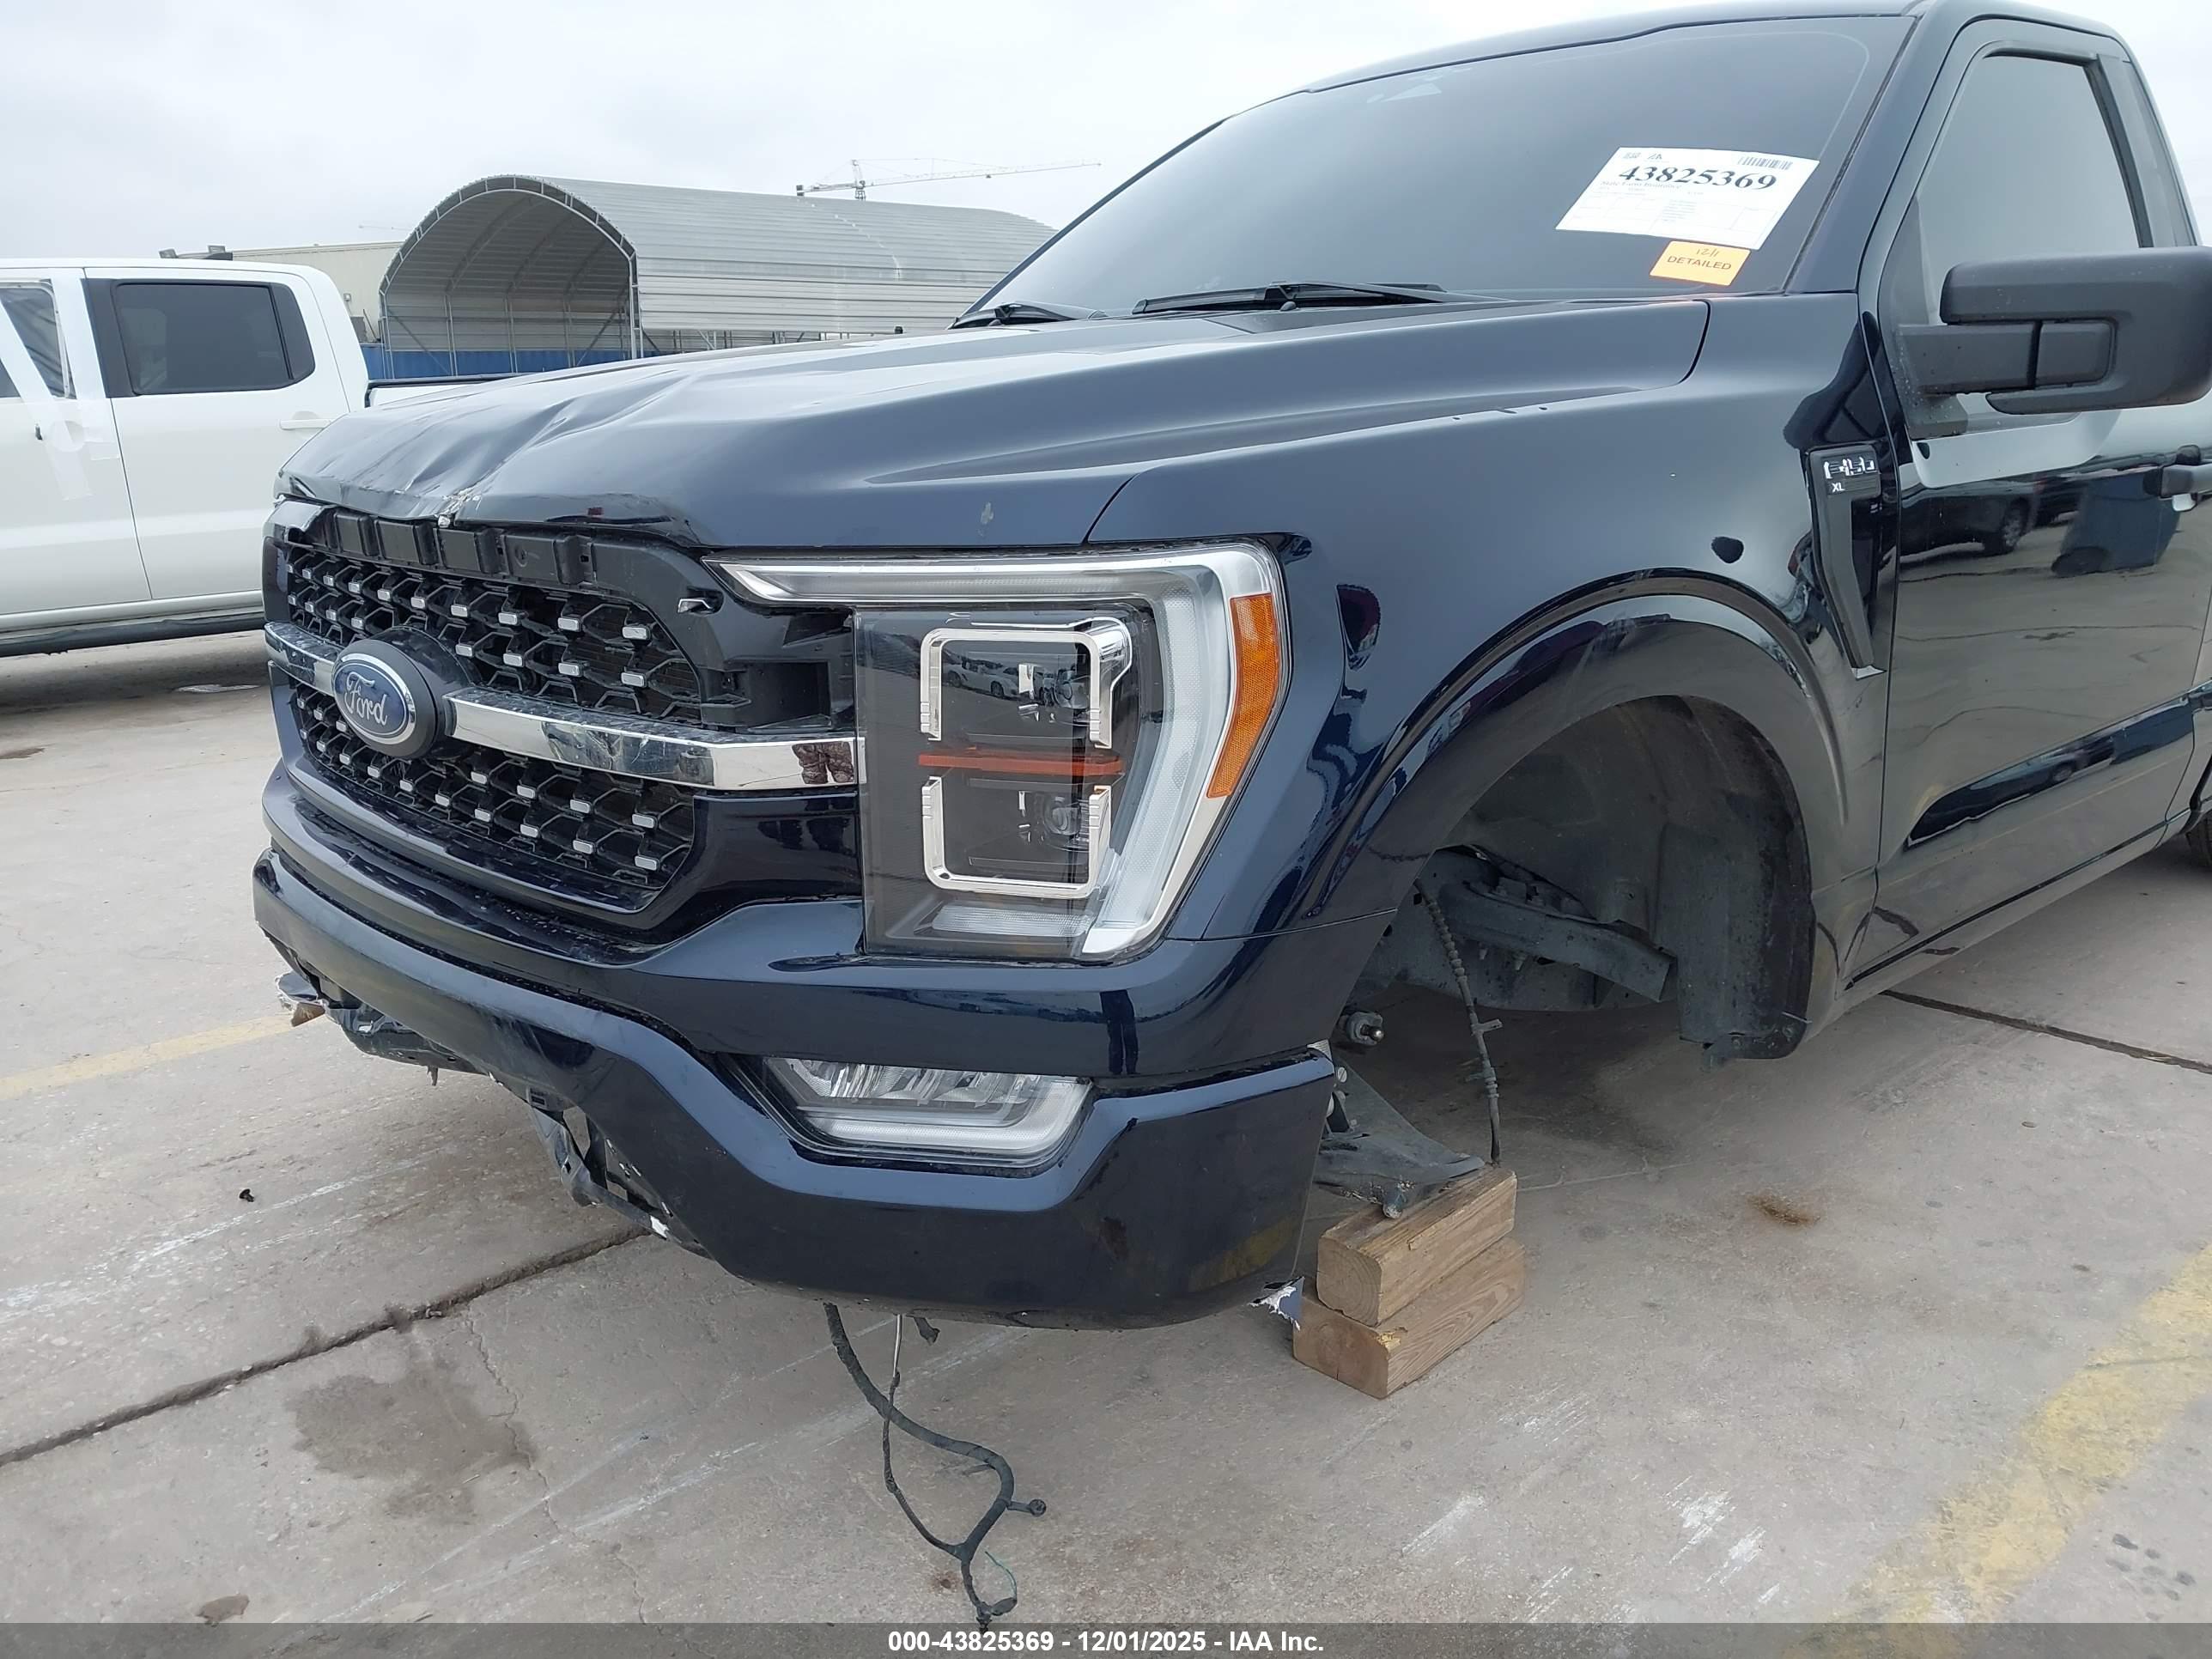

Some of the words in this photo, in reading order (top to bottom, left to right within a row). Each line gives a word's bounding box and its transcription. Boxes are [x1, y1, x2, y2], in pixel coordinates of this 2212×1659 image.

[1619, 165, 1778, 191] 43825369
[1667, 255, 1733, 270] DETAILED
[1831, 482, 1846, 493] XL
[343, 671, 388, 726] Ford
